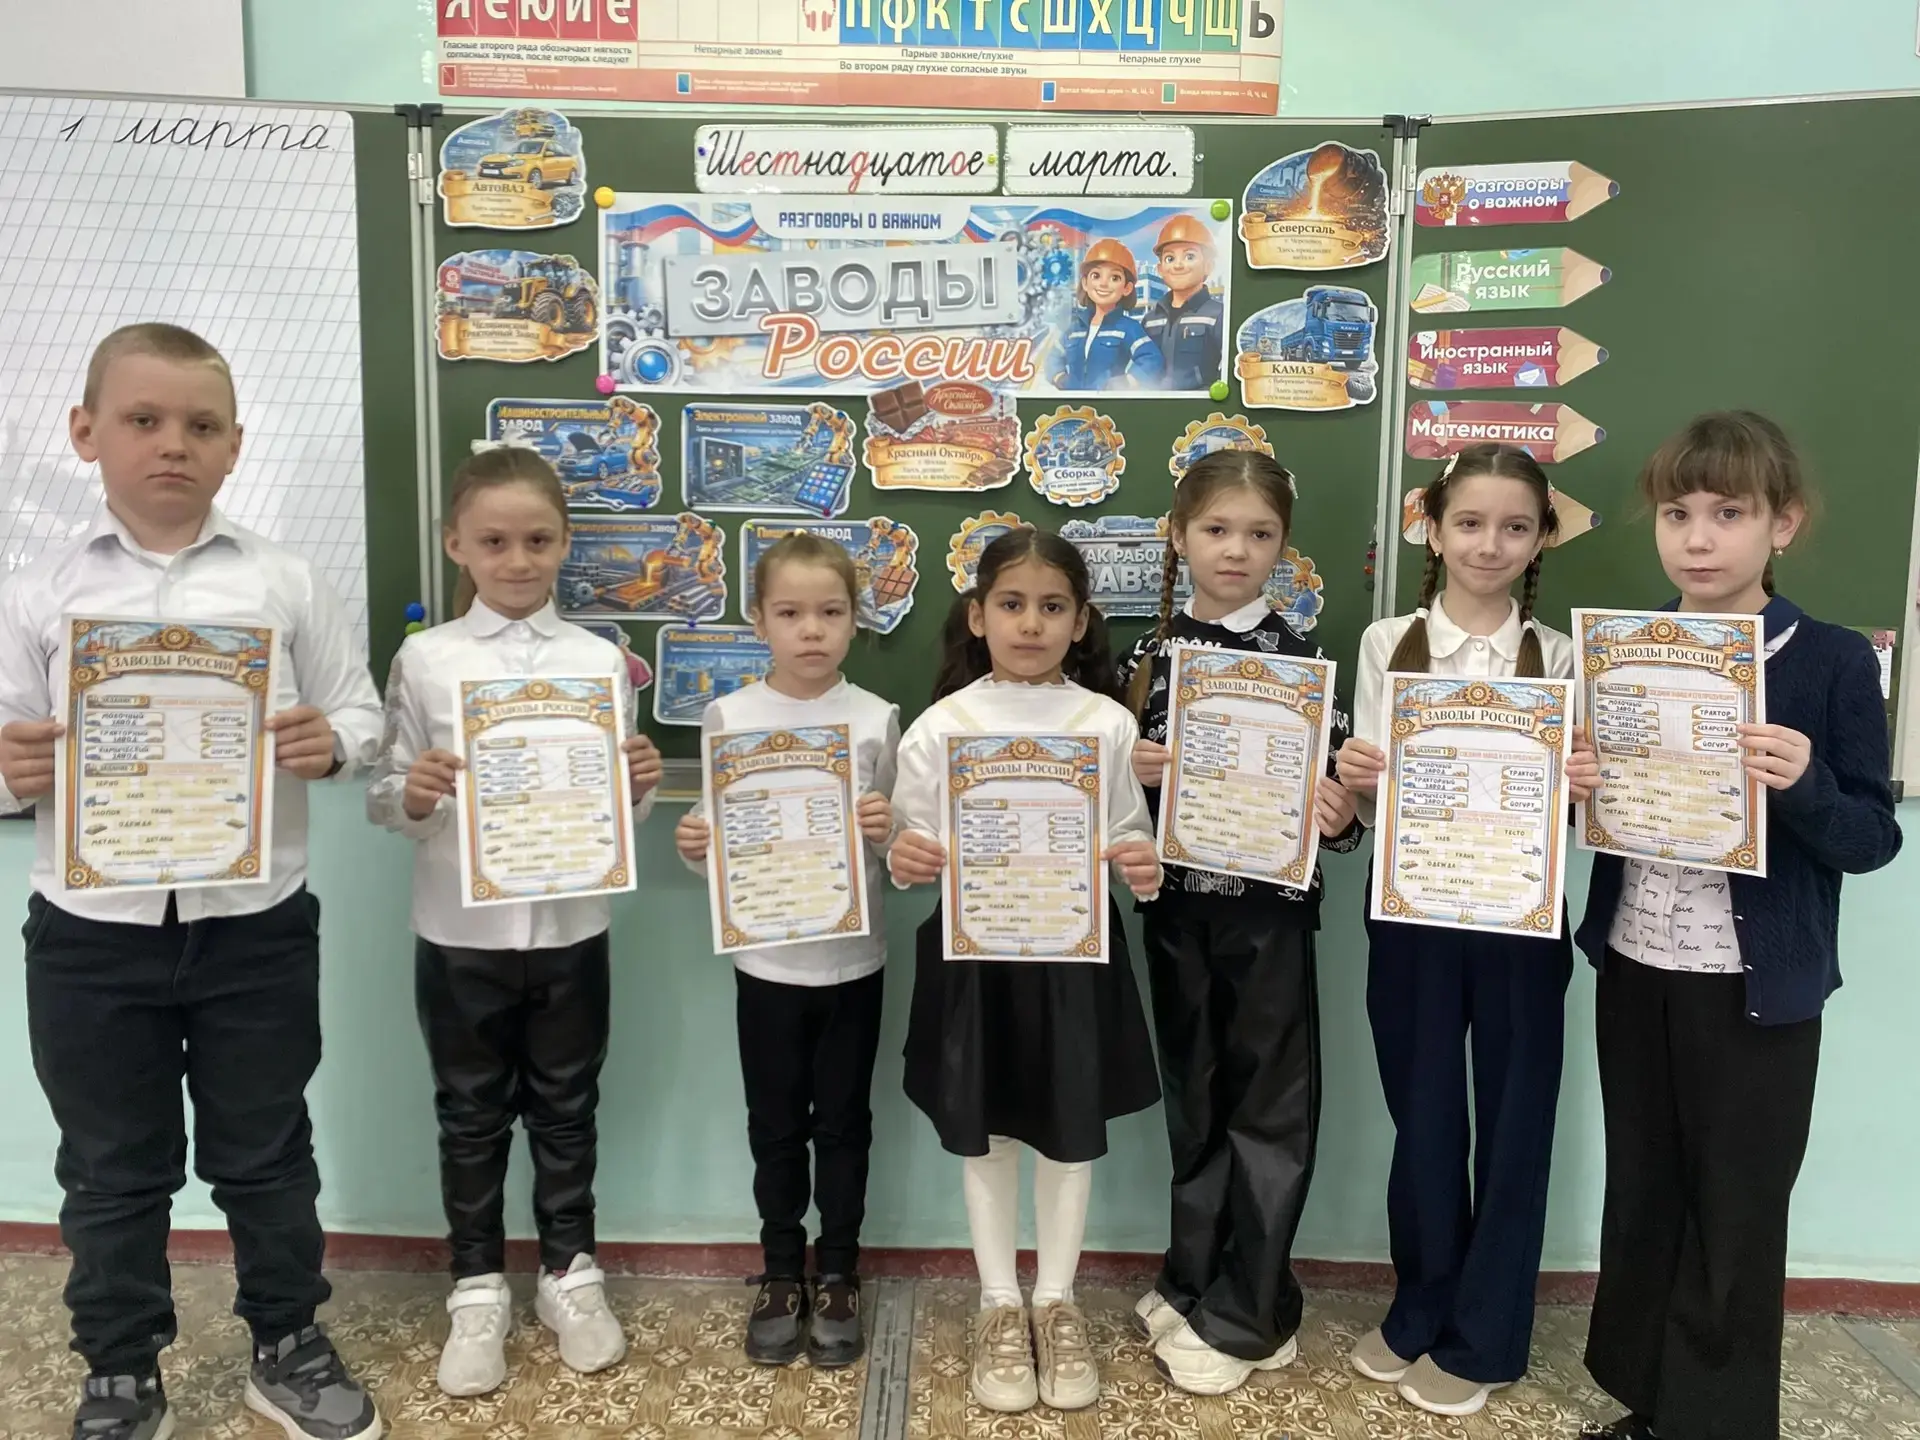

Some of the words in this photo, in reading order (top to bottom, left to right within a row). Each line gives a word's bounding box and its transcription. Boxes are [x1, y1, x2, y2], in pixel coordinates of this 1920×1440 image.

[443, 40, 477, 49] Гласные
[480, 42, 514, 51] второго
[517, 43, 538, 52] ряда
[540, 44, 591, 53] обозначают
[593, 46, 632, 54] мягкость
[694, 44, 742, 55] Непарные
[744, 47, 783, 56] звонкие
[492, 52, 524, 61] звуков,
[554, 54, 590, 63] которых
[593, 55, 629, 64] следуют
[901, 48, 938, 59] Парные
[940, 50, 1014, 61] звонкие/глухие
[1119, 53, 1167, 64] Непарные
[1169, 55, 1202, 65] глухие
[839, 60, 853, 70] Во
[854, 62, 889, 73] втором
[891, 64, 914, 74] ряду
[916, 64, 948, 74] глухие
[950, 65, 998, 75] согласные
[1000, 66, 1027, 75] звуки
[60, 115, 85, 142] 1
[705, 129, 985, 194] Шестнадцатое
[1029, 147, 1179, 194] марта.
[1464, 178, 1564, 195] Разговоры
[1468, 199, 1480, 210] о
[1484, 195, 1558, 209] важном
[778, 211, 863, 230] РАЗГОВОРЫ
[868, 212, 877, 230] О
[881, 211, 942, 230] ВАЖНОМ
[1271, 223, 1336, 235] Северсталь
[1456, 259, 1550, 284] Русский
[692, 256, 1001, 322] ЗАВОДЫ
[1475, 284, 1530, 300] язык
[757, 310, 1035, 383] России
[1420, 341, 1553, 361] Иностранный
[1272, 363, 1314, 375] КАМАЗ
[1462, 361, 1509, 375] язык
[694, 410, 768, 424] Электронный
[499, 419, 544, 432] ЗАВОД
[1411, 418, 1555, 441] Математика
[887, 447, 937, 461] Красный
[939, 448, 984, 461] Октябрь
[1054, 469, 1096, 480] Сборка
[811, 527, 852, 541] ЗАВОД
[1613, 647, 1662, 659] ЗАВОДЫ
[1667, 647, 1720, 665] РОССИИ
[1205, 680, 1248, 692] ЗАВОДЫ
[1252, 683, 1296, 701] РОССИИ
[1607, 684, 1631, 693] ЗАДАНИЕ
[1608, 700, 1642, 708] МОЛОЧНЫЙ
[1423, 710, 1475, 722] ЗАВОДЫ
[1480, 710, 1531, 727] РОССИИ
[1607, 714, 1647, 724] ТРАКТОРНЫЙ
[1700, 709, 1731, 717] ТРАКТОР
[1607, 729, 1649, 738] ХИМИЧЕСКИЙ
[1619, 735, 1639, 743] ЗАВОД
[1702, 740, 1730, 748] ЙОГУРТ
[1416, 761, 1452, 769] МОЛОЧНЫЙ
[1609, 756, 1628, 764] ЗЕРНО
[1424, 767, 1446, 775] ЗАВОД
[1699, 769, 1721, 777] ТЕСТО
[1414, 776, 1456, 785] ТРАКТОРНЫЙ
[1605, 782, 1630, 790] ХЛОПОК
[1424, 783, 1446, 791] ЗАВОД
[1653, 789, 1672, 797] ТКАНЬ
[1413, 791, 1456, 800] ХИМИЧЕСКИЙ
[1627, 795, 1655, 805] ОДЕЖДА
[1424, 798, 1446, 806] ЗАВОД
[1509, 800, 1535, 808] ЙОГУРТ
[1604, 808, 1629, 816] МЕТАЛЛ
[1649, 814, 1672, 823] ДЕТАЛИ
[1504, 829, 1525, 837] ТЕСТО
[1455, 852, 1475, 860] ТКАНЬ
[1427, 861, 1456, 869] ОДЕЖДА
[1682, 865, 1704, 876] love
[1404, 873, 1429, 881] МЕТАЛЛ
[1648, 864, 1670, 880] love
[1449, 877, 1475, 886] ДЕТАЛИ
[1672, 903, 1694, 914] love
[1645, 939, 1666, 953] love
[1677, 939, 1702, 951] love
[1714, 941, 1732, 950] love
